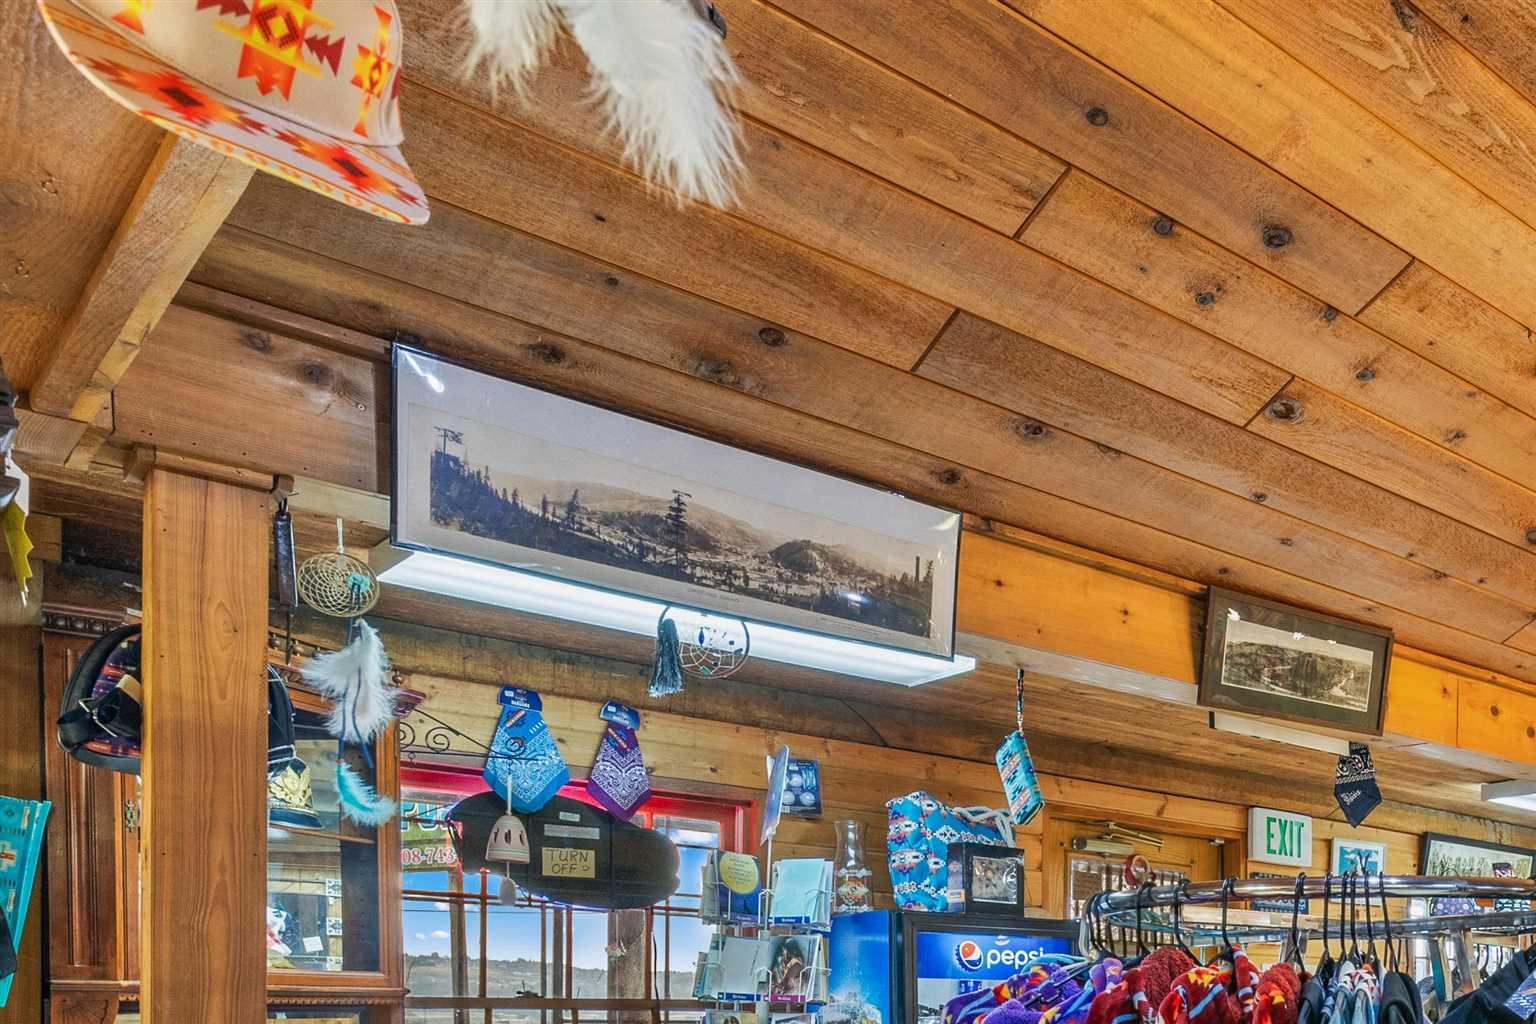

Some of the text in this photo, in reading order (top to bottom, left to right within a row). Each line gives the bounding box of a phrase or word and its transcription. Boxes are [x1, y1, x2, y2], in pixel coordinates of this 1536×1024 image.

[1266, 816, 1305, 858] EXIT
[545, 849, 588, 862] TURN
[552, 863, 577, 874] OFF
[987, 947, 1044, 969] pepsi
